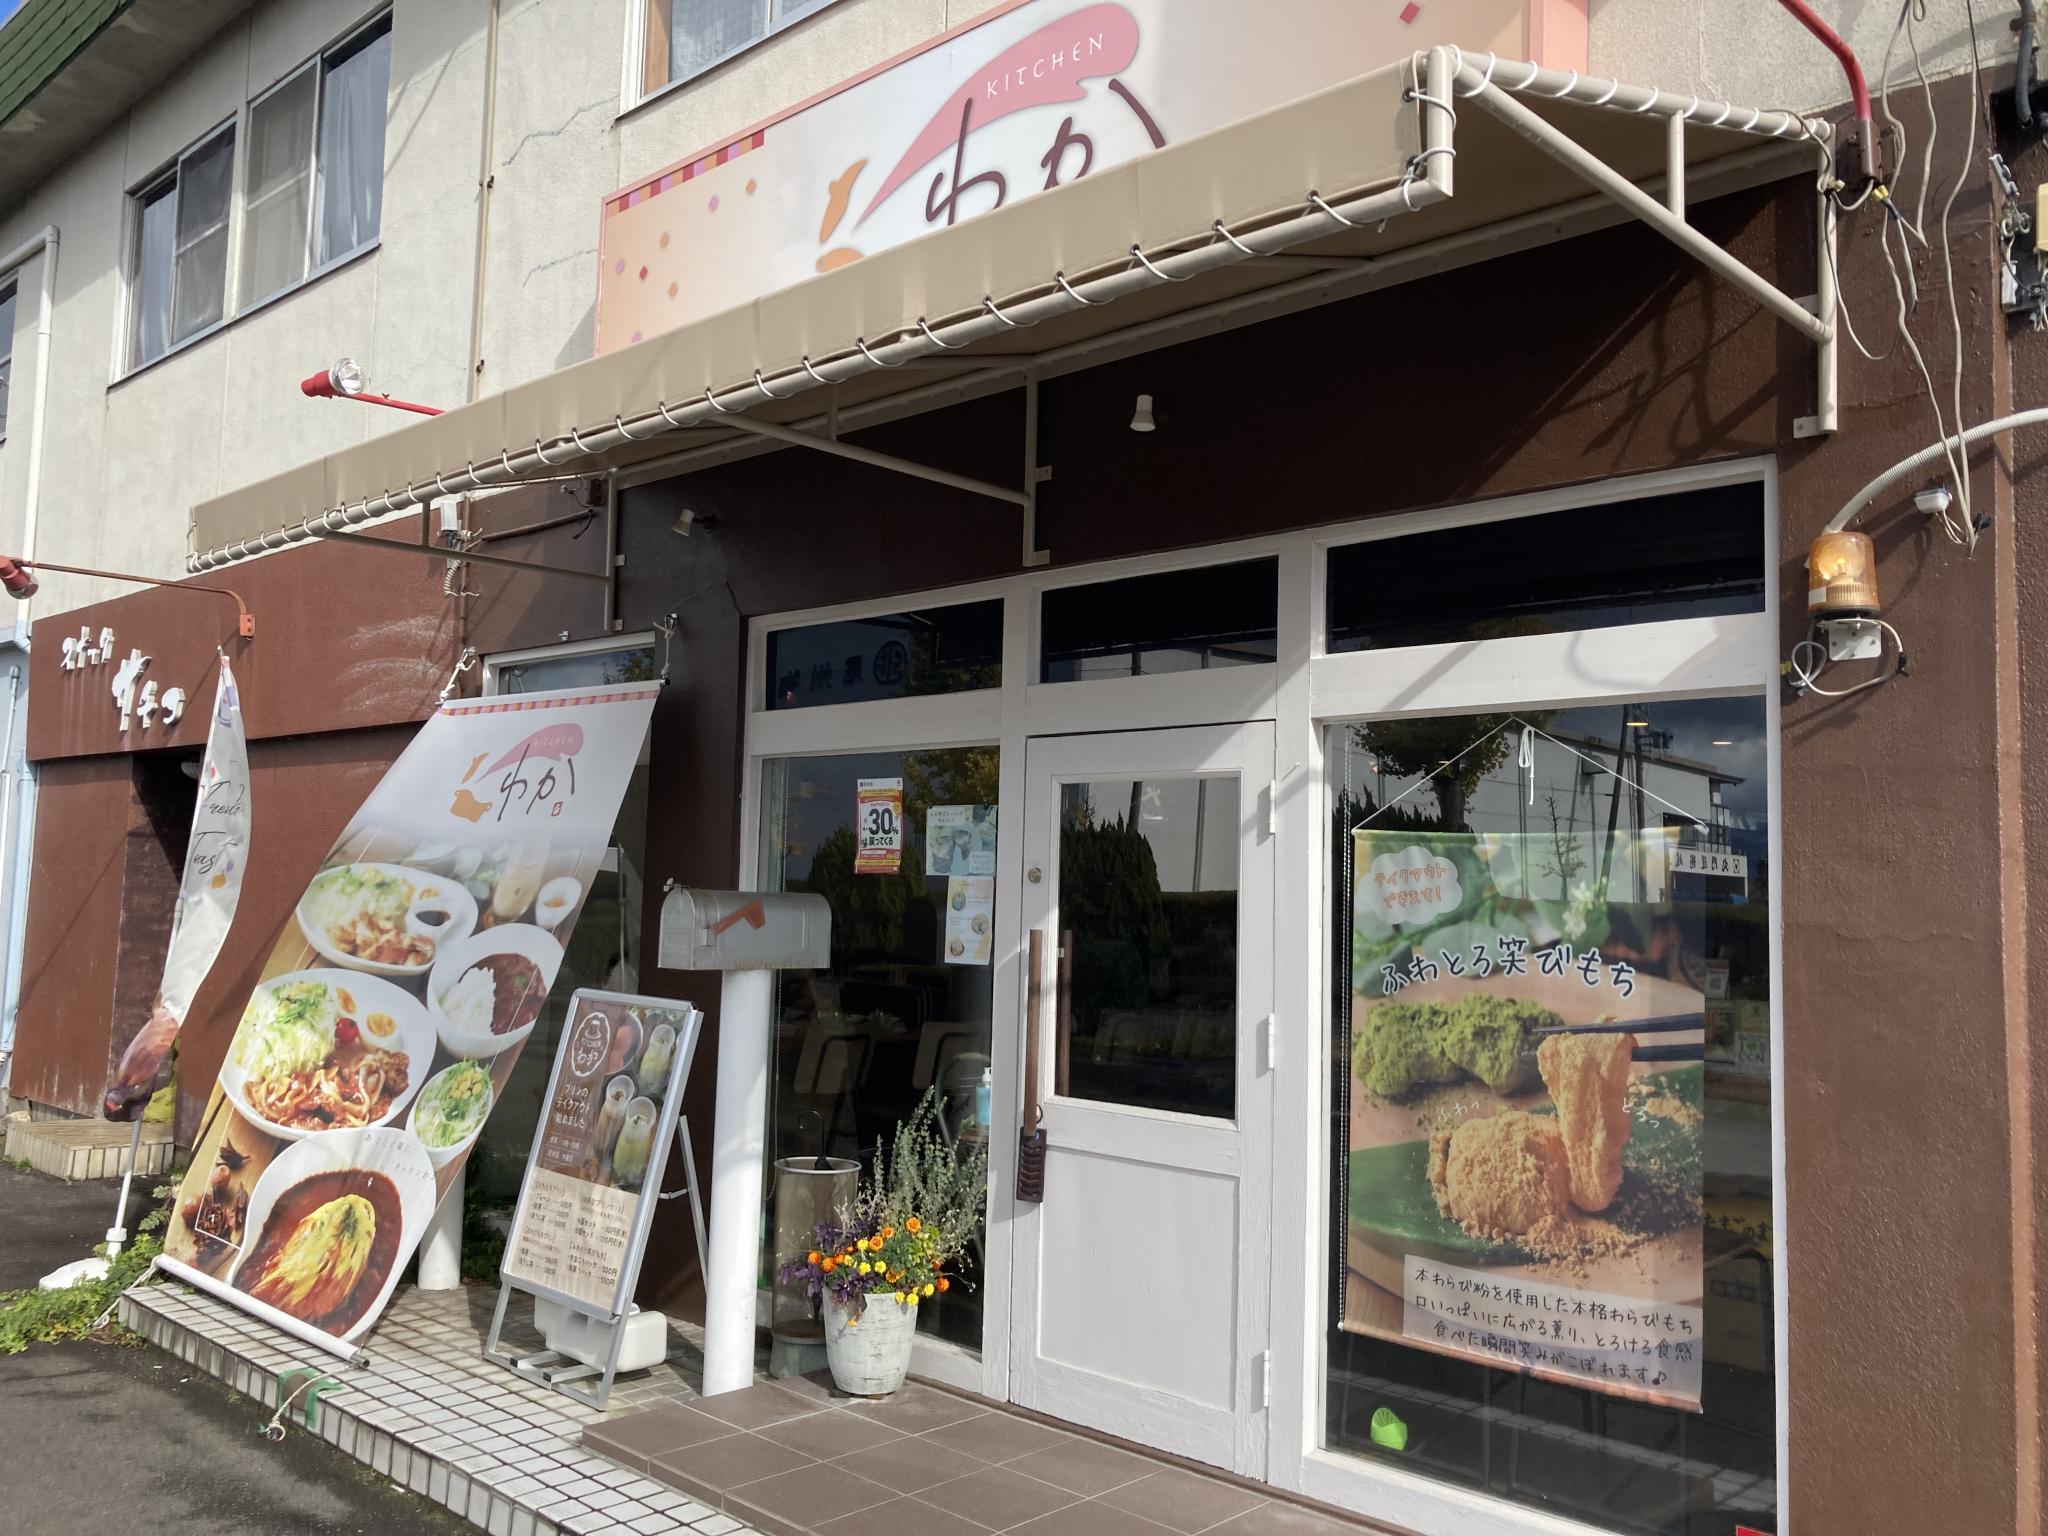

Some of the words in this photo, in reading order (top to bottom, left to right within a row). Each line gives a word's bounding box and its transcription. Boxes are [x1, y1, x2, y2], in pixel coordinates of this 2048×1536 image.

[986, 33, 1104, 99] KITCHEN
[533, 735, 575, 748] KITCHEN
[497, 744, 576, 822] わか
[868, 837, 894, 847] 戻ってくる
[1374, 863, 1446, 888] テイクアウト
[1381, 936, 1637, 998] ふわとろ笑びもち
[556, 1098, 591, 1115] テイクアウト
[1415, 1267, 1693, 1335] 本わらび粉を使用した本格わらびもち
[1415, 1295, 1694, 1363] 口いっぱいに広がる薫り、とろける食感
